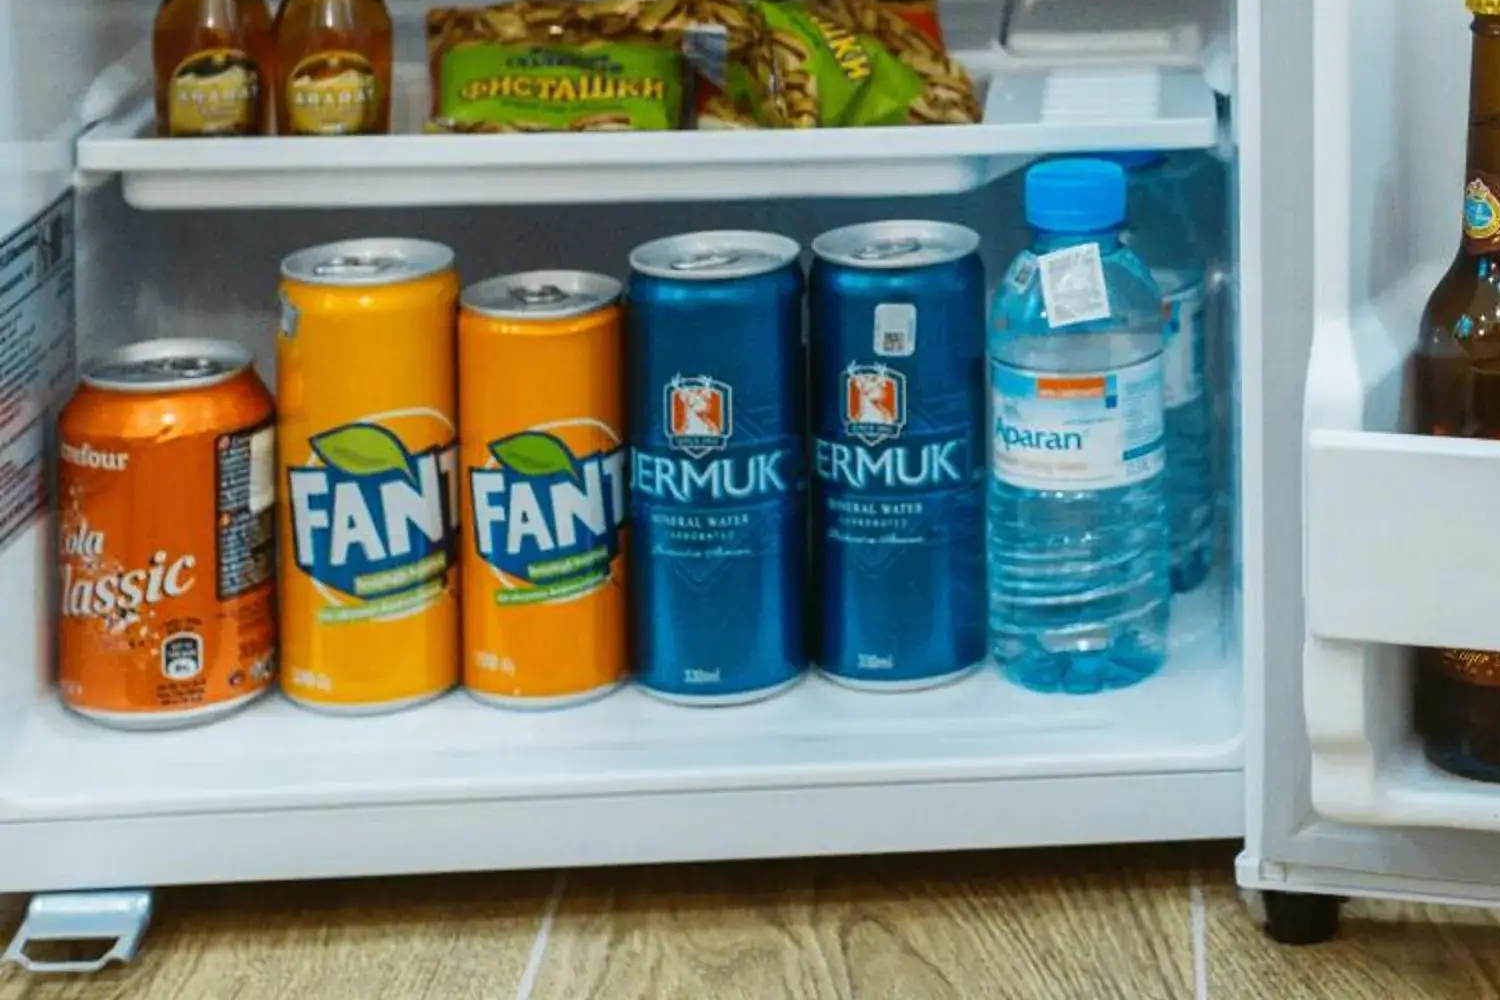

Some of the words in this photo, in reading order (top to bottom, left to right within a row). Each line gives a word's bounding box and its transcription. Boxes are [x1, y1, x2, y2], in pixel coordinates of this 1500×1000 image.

[996, 416, 1083, 451] Aparan
[66, 517, 105, 553] ola
[63, 550, 196, 618] lassic
